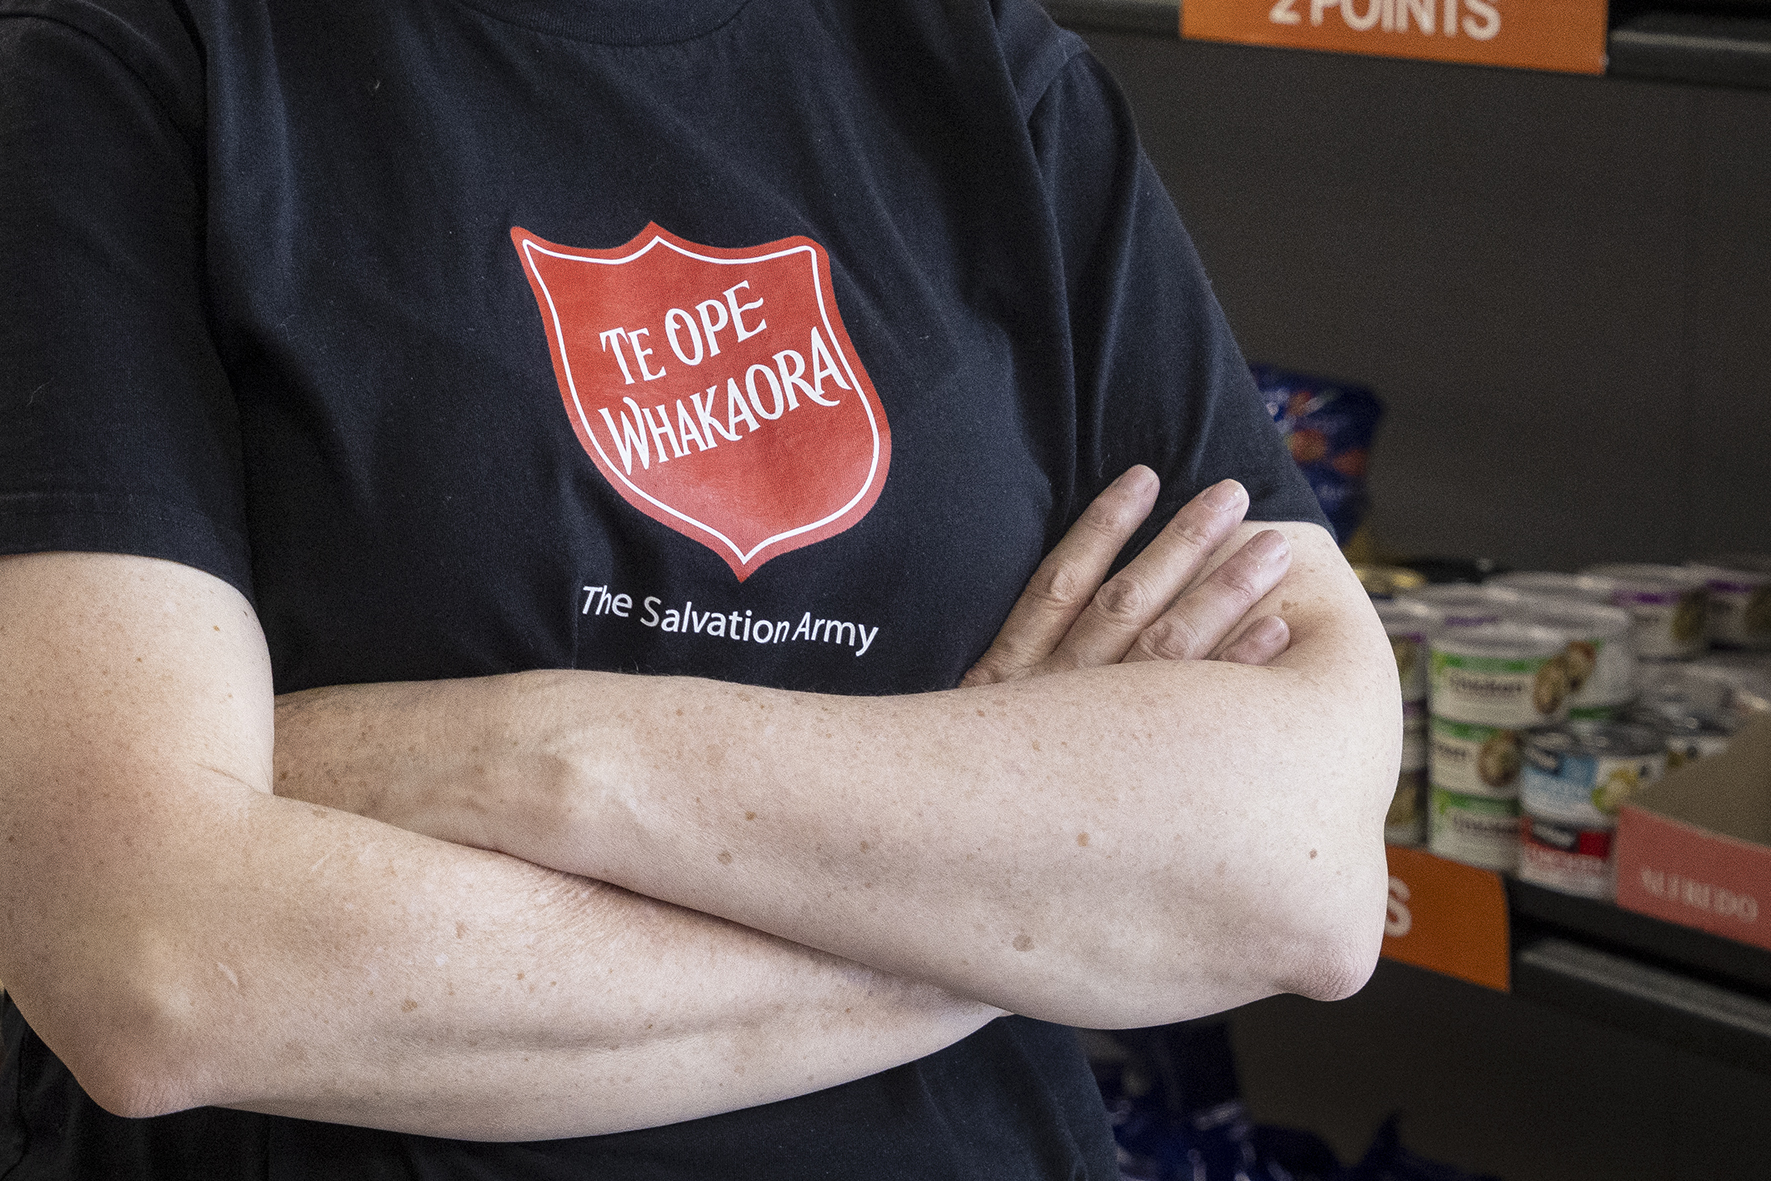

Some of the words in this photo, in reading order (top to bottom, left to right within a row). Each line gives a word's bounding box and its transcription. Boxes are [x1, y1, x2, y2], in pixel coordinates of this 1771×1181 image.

[599, 327, 666, 384] TE
[664, 280, 767, 366] OPE
[598, 326, 852, 475] WHAKAORA
[581, 584, 632, 619] The
[640, 595, 790, 645] Salvation
[793, 612, 879, 657] Army
[1639, 866, 1760, 921] ALFREDO
